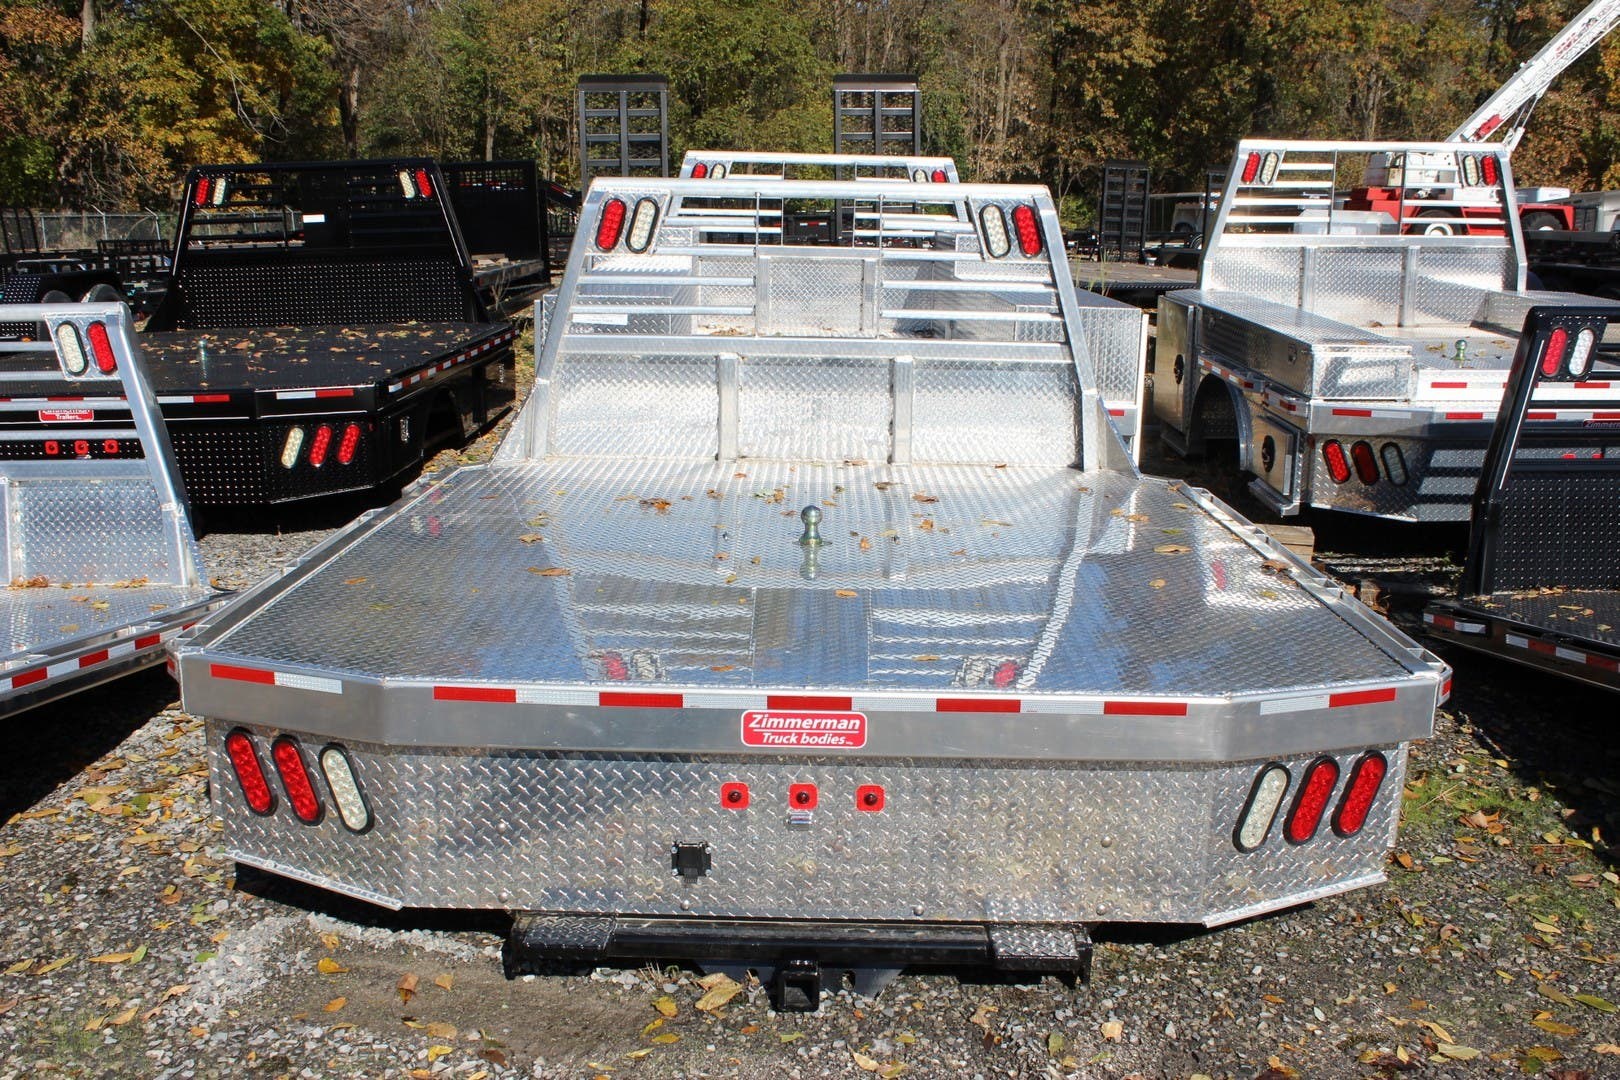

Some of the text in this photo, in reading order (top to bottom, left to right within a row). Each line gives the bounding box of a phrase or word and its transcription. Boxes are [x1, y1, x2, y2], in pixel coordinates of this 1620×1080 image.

[748, 714, 860, 730] Zimmerman
[762, 732, 846, 745] Truck bodies
